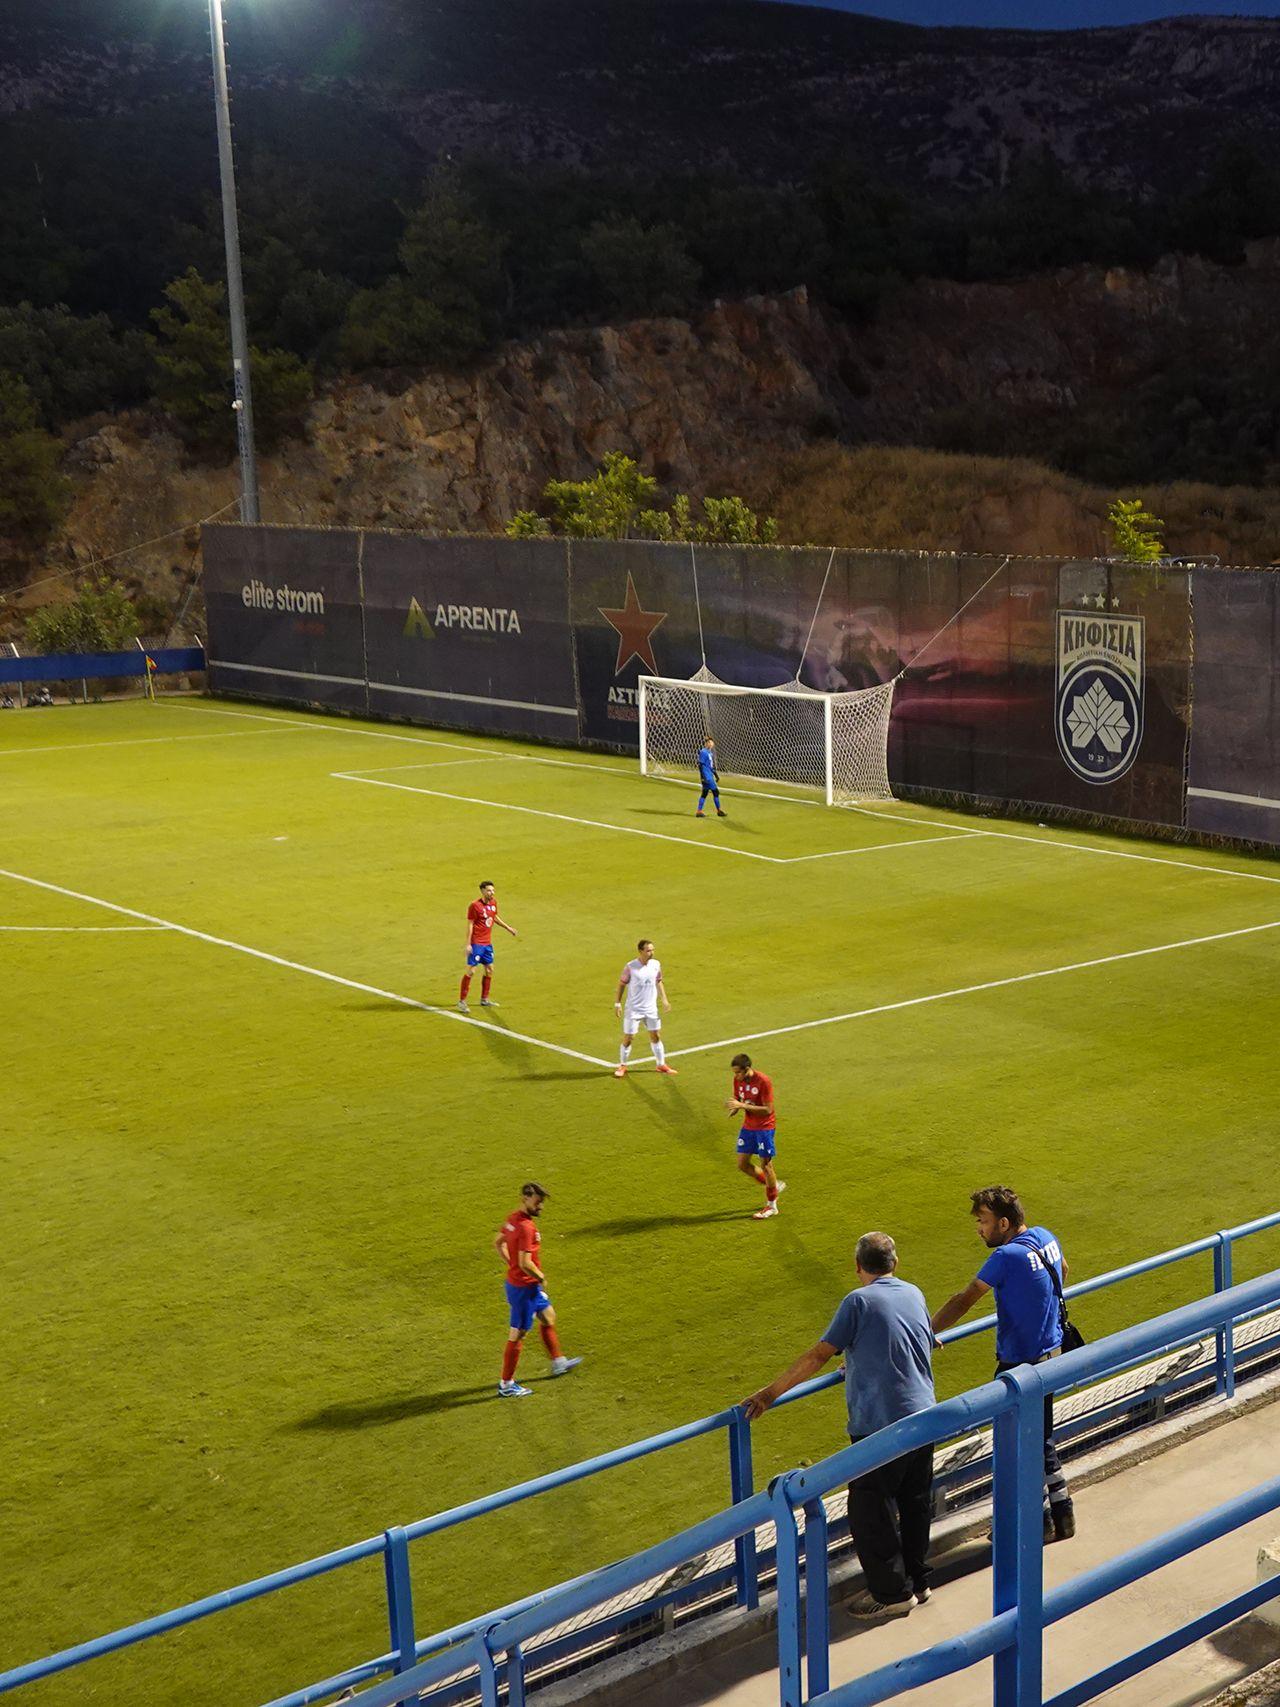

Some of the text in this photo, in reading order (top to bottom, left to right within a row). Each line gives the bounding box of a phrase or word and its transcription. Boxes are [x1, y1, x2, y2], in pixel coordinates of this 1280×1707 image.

[241, 580, 325, 614] elite strom
[434, 604, 521, 634] APRENTA
[1063, 619, 1137, 661] ΚΗΦΙΣΙΑ
